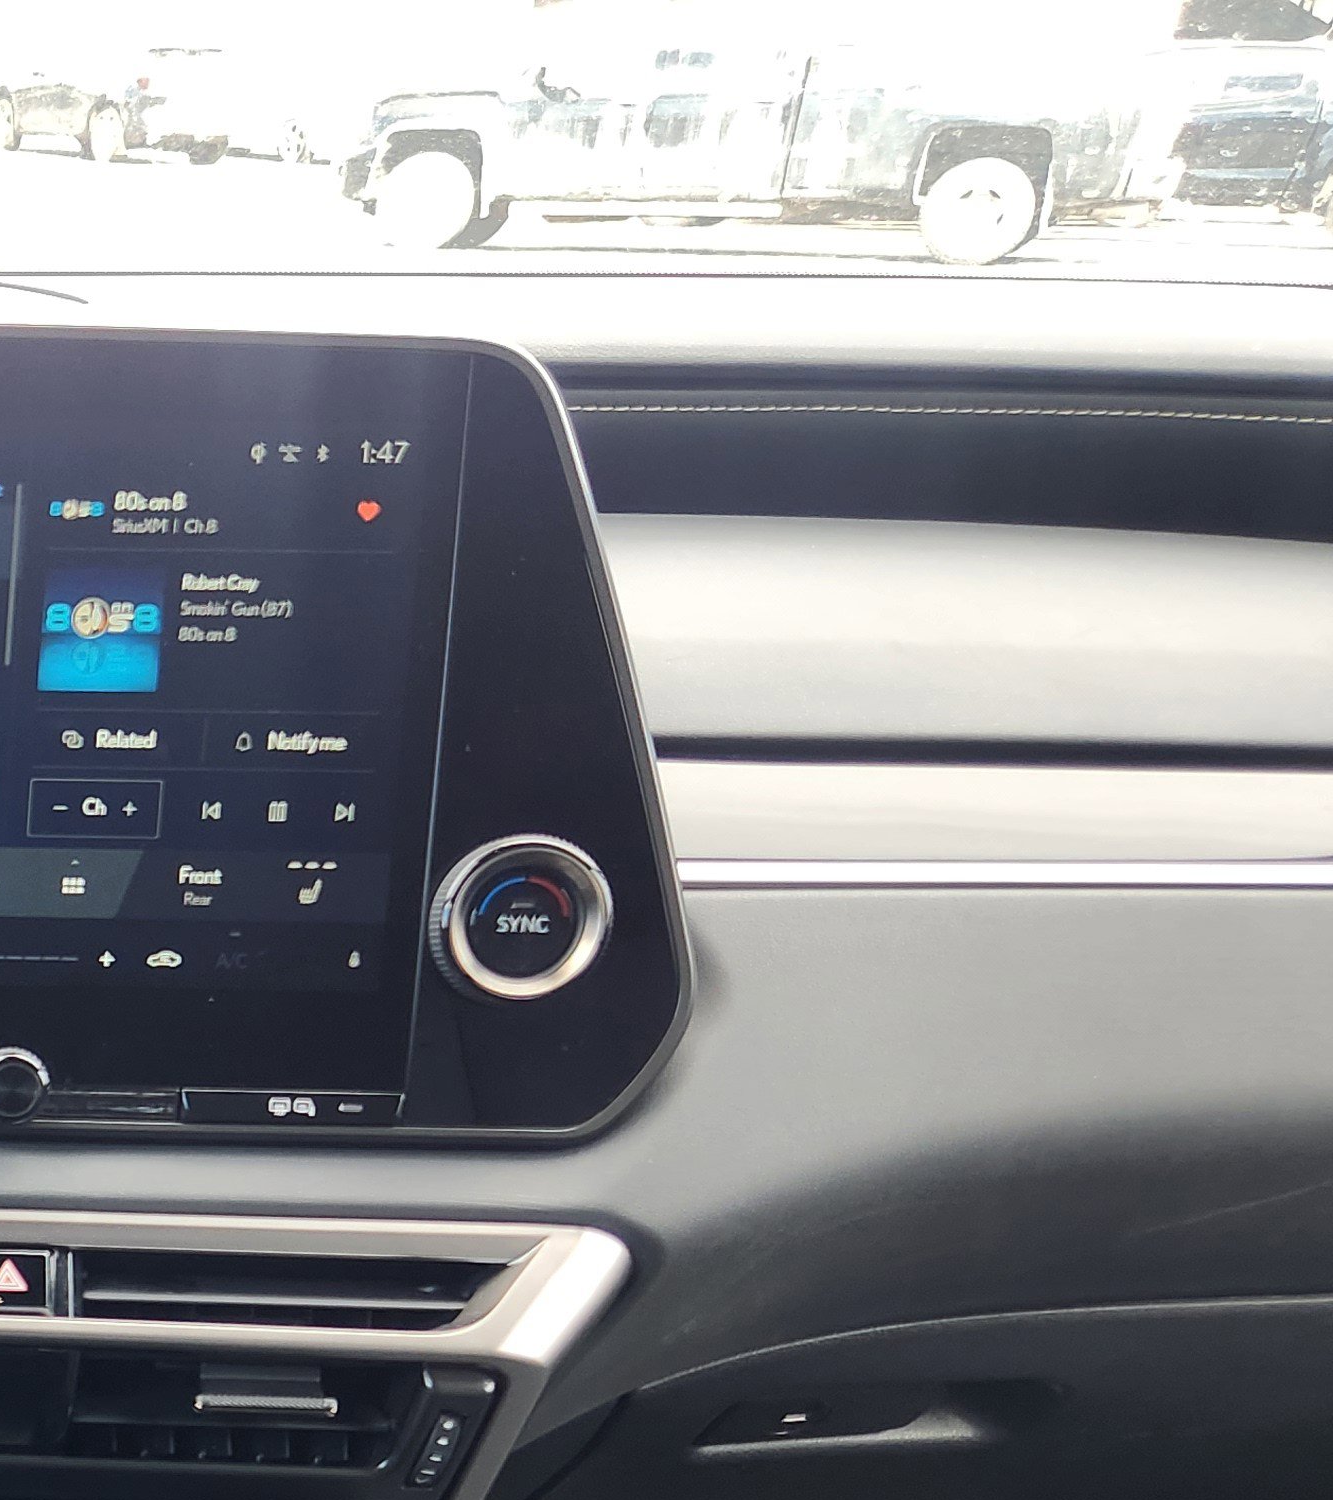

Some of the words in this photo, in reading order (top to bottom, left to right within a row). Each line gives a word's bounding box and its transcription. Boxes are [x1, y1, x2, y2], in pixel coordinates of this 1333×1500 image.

[360, 439, 411, 465] 1:47
[181, 572, 227, 591] Robert
[231, 600, 260, 617] Gun
[94, 728, 158, 750] Related
[266, 730, 319, 756] Notify
[318, 736, 349, 752] me
[81, 795, 108, 817] Ch
[177, 863, 223, 886] Front
[183, 891, 213, 907] Rear
[495, 913, 551, 935] SYNC
